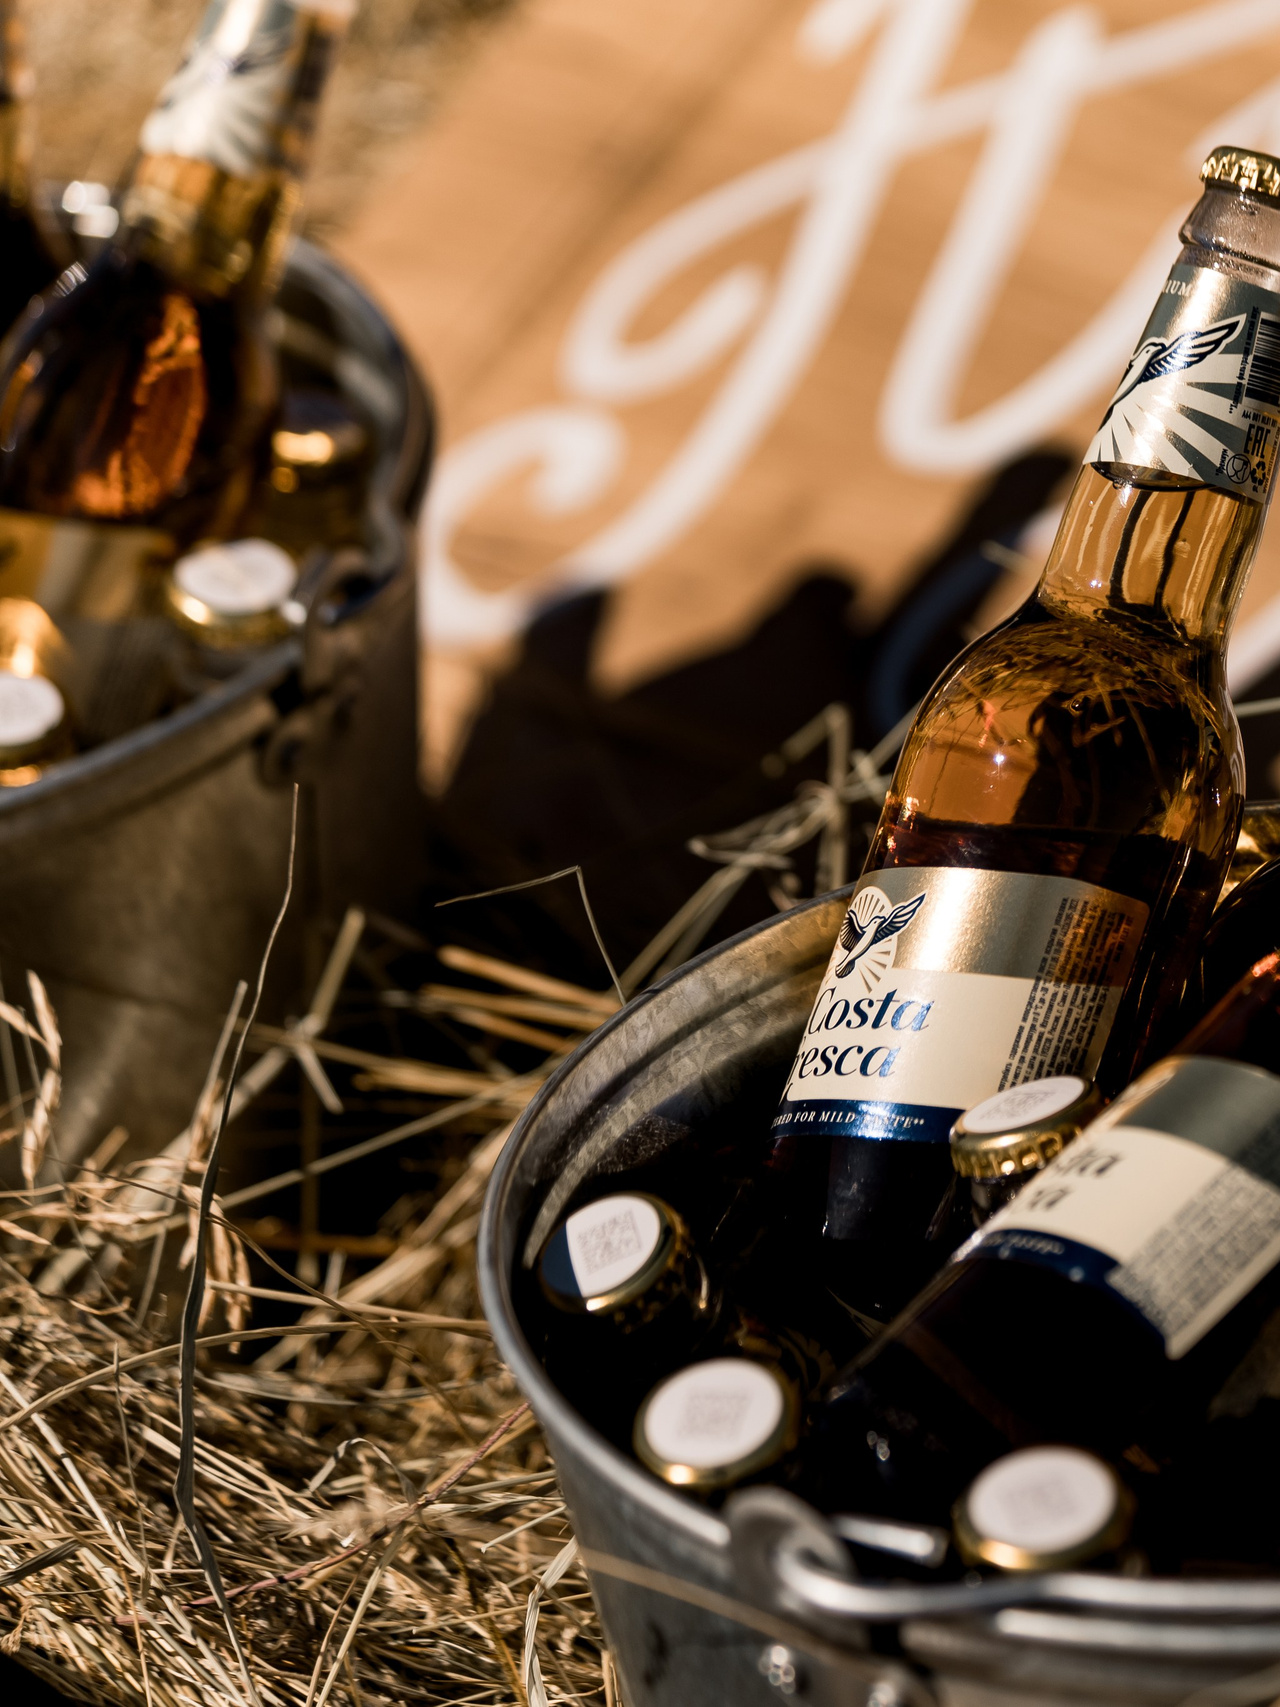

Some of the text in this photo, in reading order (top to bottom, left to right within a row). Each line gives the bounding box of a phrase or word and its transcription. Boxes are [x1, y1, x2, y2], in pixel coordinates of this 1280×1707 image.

[808, 986, 935, 1035] Costa
[787, 1037, 901, 1085] resca
[794, 1111, 817, 1124] FOR
[819, 1110, 856, 1125] MILD
